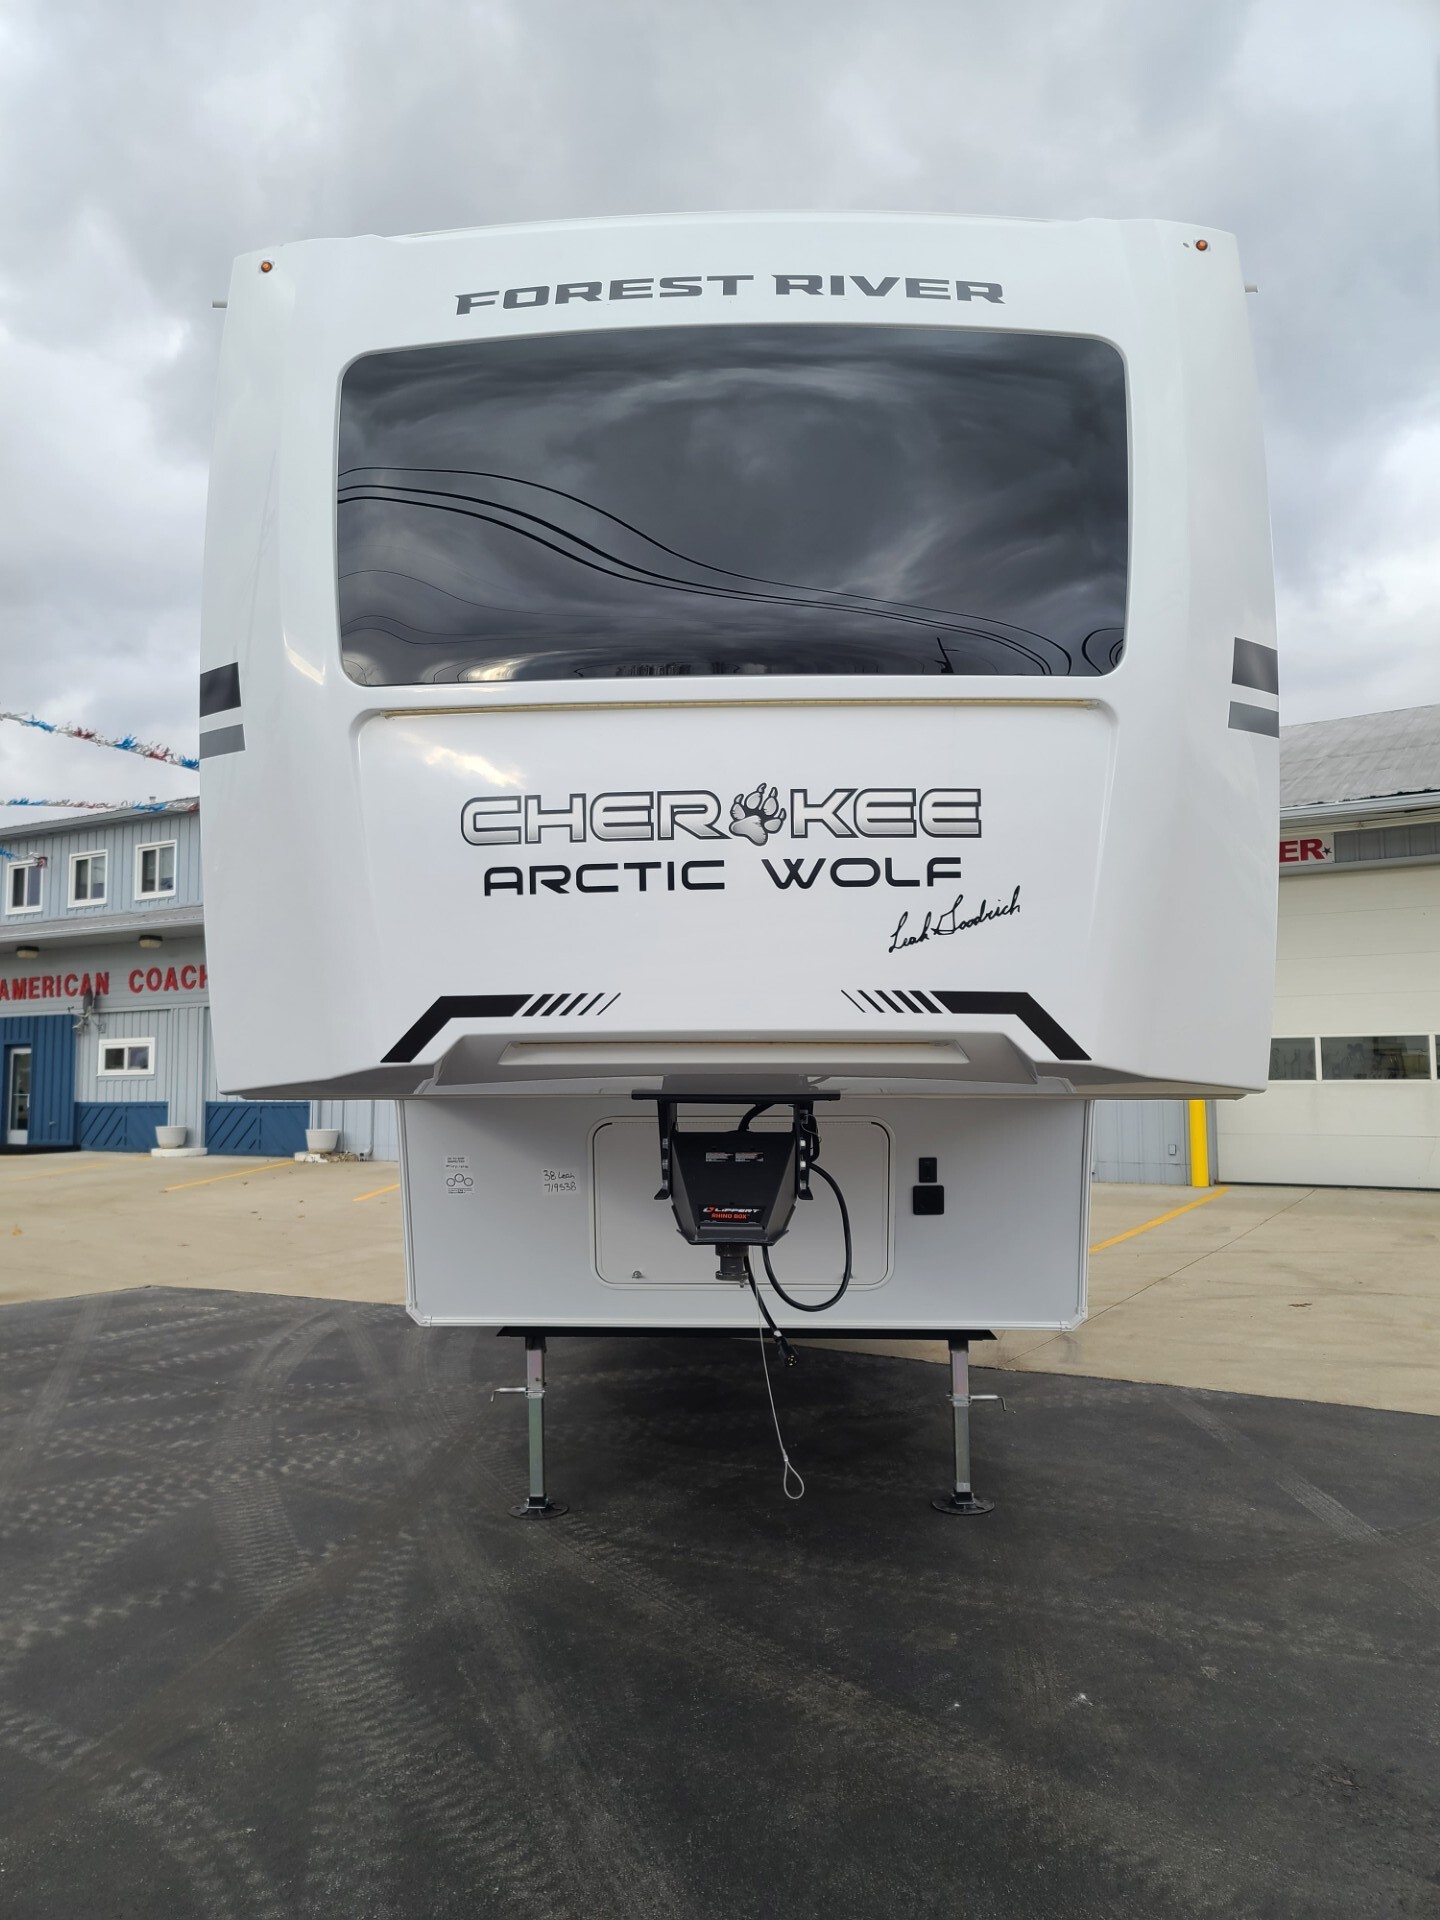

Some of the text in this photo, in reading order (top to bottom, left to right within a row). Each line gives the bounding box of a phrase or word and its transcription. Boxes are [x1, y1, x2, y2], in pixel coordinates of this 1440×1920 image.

[455, 274, 1006, 315] FOREST RIVER
[460, 782, 982, 846] CHERKEE
[484, 857, 962, 896] ARCTIC WOLF
[0, 971, 110, 1000] AMERICAN
[543, 1169, 557, 1181] 38
